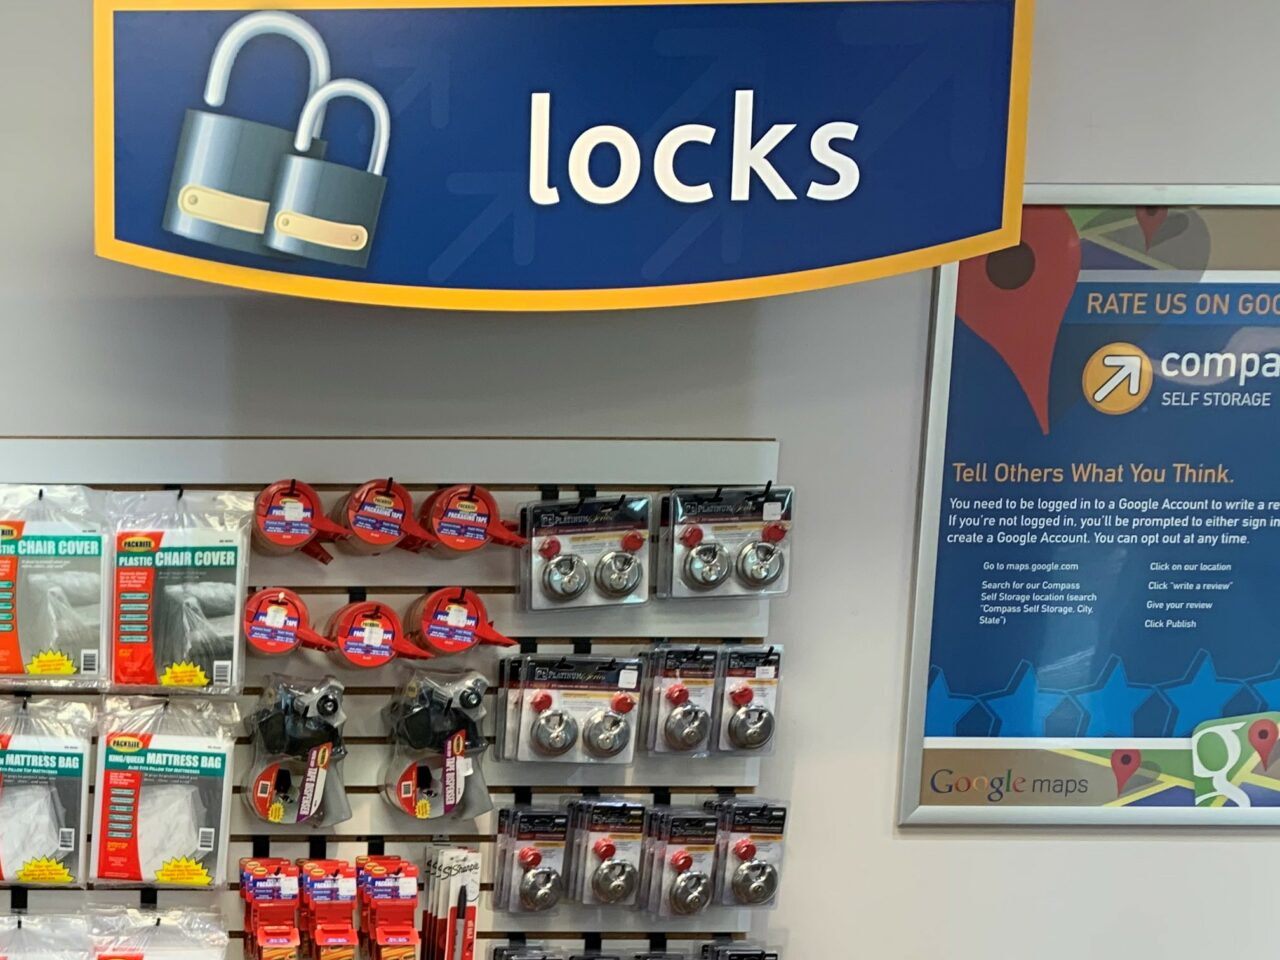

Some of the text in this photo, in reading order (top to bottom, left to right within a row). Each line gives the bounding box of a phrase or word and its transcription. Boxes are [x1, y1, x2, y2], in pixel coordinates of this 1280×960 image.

[529, 89, 861, 205] locks
[1087, 293, 1147, 314] RATE
[1155, 293, 1187, 314] US
[1196, 293, 1229, 314] ON
[1162, 392, 1271, 406] SELF STORAGE
[952, 463, 1234, 483] Tell Others What You Think.
[950, 498, 970, 509] You
[973, 498, 1003, 509] need
[1005, 498, 1016, 509] to
[1020, 498, 1034, 509] be
[1038, 498, 1077, 511] logged
[1080, 498, 1091, 509] in
[1094, 499, 1106, 510] to
[1108, 502, 1115, 510] a
[1119, 498, 1158, 511] Google
[1162, 498, 1208, 510] Account
[1211, 499, 1223, 510] to
[1225, 499, 1255, 510] write
[1257, 502, 1264, 510] a
[949, 515, 957, 526] If
[999, 516, 1018, 526] not
[1020, 515, 1060, 528] logged
[1063, 515, 1077, 527] in,
[1115, 515, 1129, 527] be
[1132, 516, 1189, 528] prompted
[1192, 516, 1203, 527] to
[1205, 516, 1240, 527] either
[1243, 516, 1267, 528] sign
[1270, 516, 1280, 527] in
[124, 540, 152, 548] PACKRITE
[947, 533, 984, 543] create
[997, 533, 1037, 546] Google
[1040, 533, 1090, 543] Account.
[1094, 533, 1114, 543] You
[1117, 535, 1138, 544] can
[1141, 533, 1160, 546] opt
[1162, 533, 1180, 543] out
[1183, 533, 1194, 544] at
[1198, 536, 1218, 546] any
[1221, 533, 1250, 544] time.
[18, 540, 98, 555] CHAIR COVER
[119, 551, 235, 566] PLASTIC CHAIR COVER
[983, 562, 1078, 572] Go to maps.google.com
[1148, 582, 1168, 590] Click
[1170, 582, 1194, 590] "write
[1203, 582, 1233, 590] review"
[5, 753, 56, 768] MATTRESS
[58, 756, 79, 768] BAG
[109, 753, 221, 768] KING/QUEEN MATTRESS BAG
[931, 768, 1088, 802] Google maps
